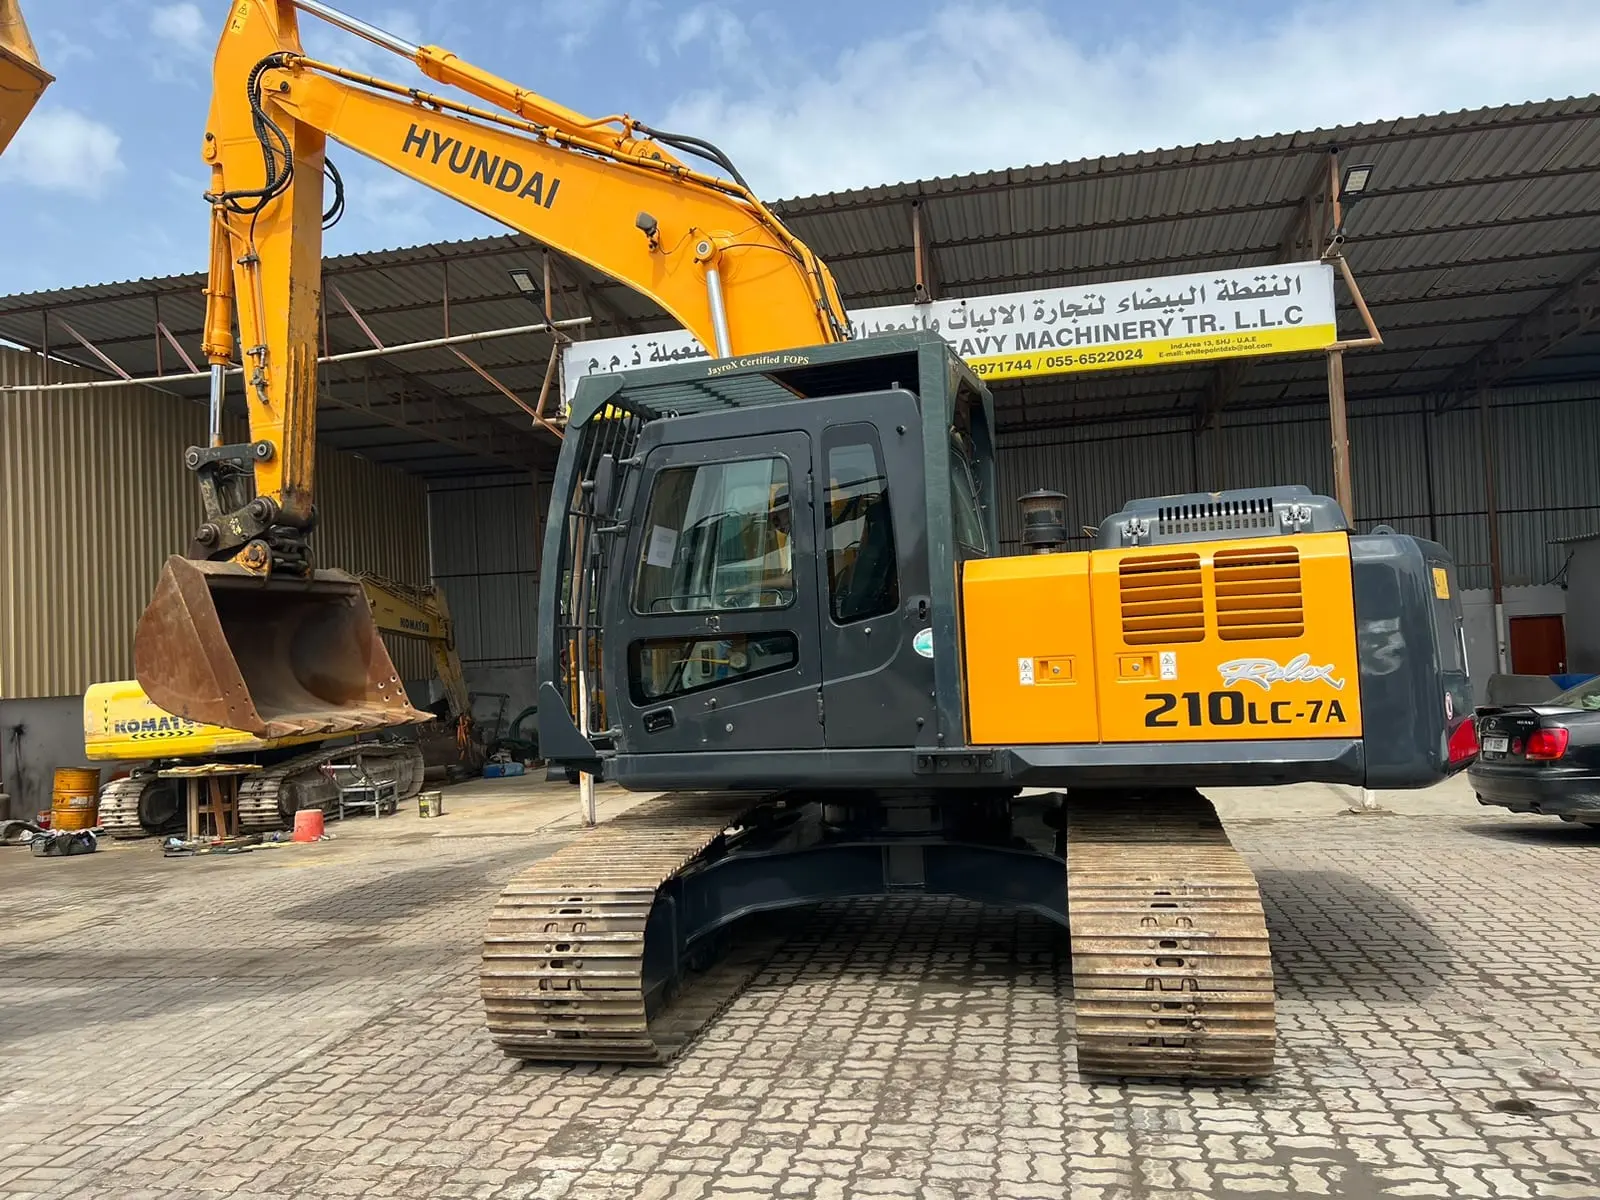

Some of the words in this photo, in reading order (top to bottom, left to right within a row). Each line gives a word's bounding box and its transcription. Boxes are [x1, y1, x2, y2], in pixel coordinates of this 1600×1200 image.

[402, 123, 560, 209] HYUNDAI
[1116, 284, 1205, 315] البيضاء
[1214, 274, 1302, 302] النقطة
[1033, 294, 1106, 325] لتجارة
[1015, 317, 1174, 351] MACHINERY
[1182, 313, 1226, 334] TR.
[1235, 305, 1303, 330] L.L.C
[1237, 336, 1257, 344] U.A.E
[707, 360, 738, 376] JayroX
[740, 355, 780, 368] Certified
[783, 355, 810, 365] FOPS
[1046, 349, 1144, 369] 055-6522024
[1144, 690, 1346, 728] 210LC-7A
